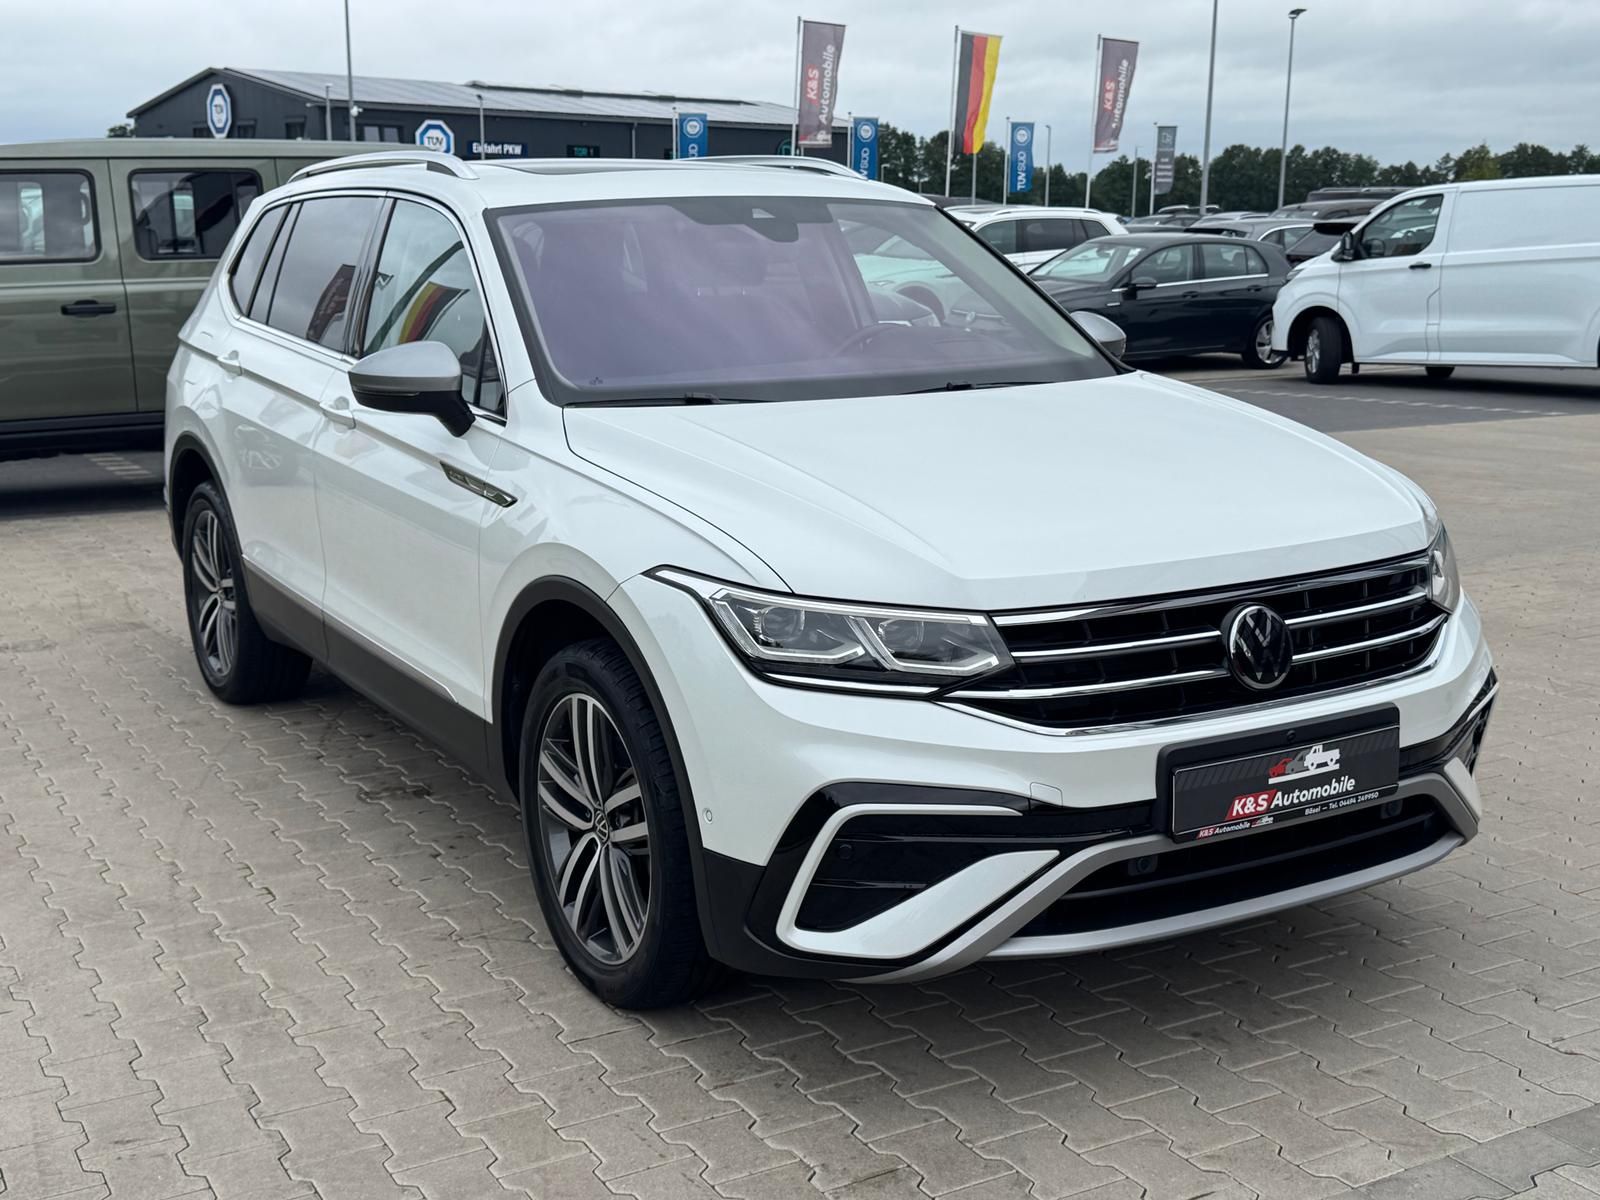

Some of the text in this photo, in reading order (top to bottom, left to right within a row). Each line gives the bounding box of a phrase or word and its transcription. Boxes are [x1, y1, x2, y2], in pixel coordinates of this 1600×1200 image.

[818, 44, 835, 125] Automobile
[503, 144, 522, 155] PKW
[1232, 775, 1355, 817] K&S Automobile
[1214, 821, 1251, 834] Automobile
